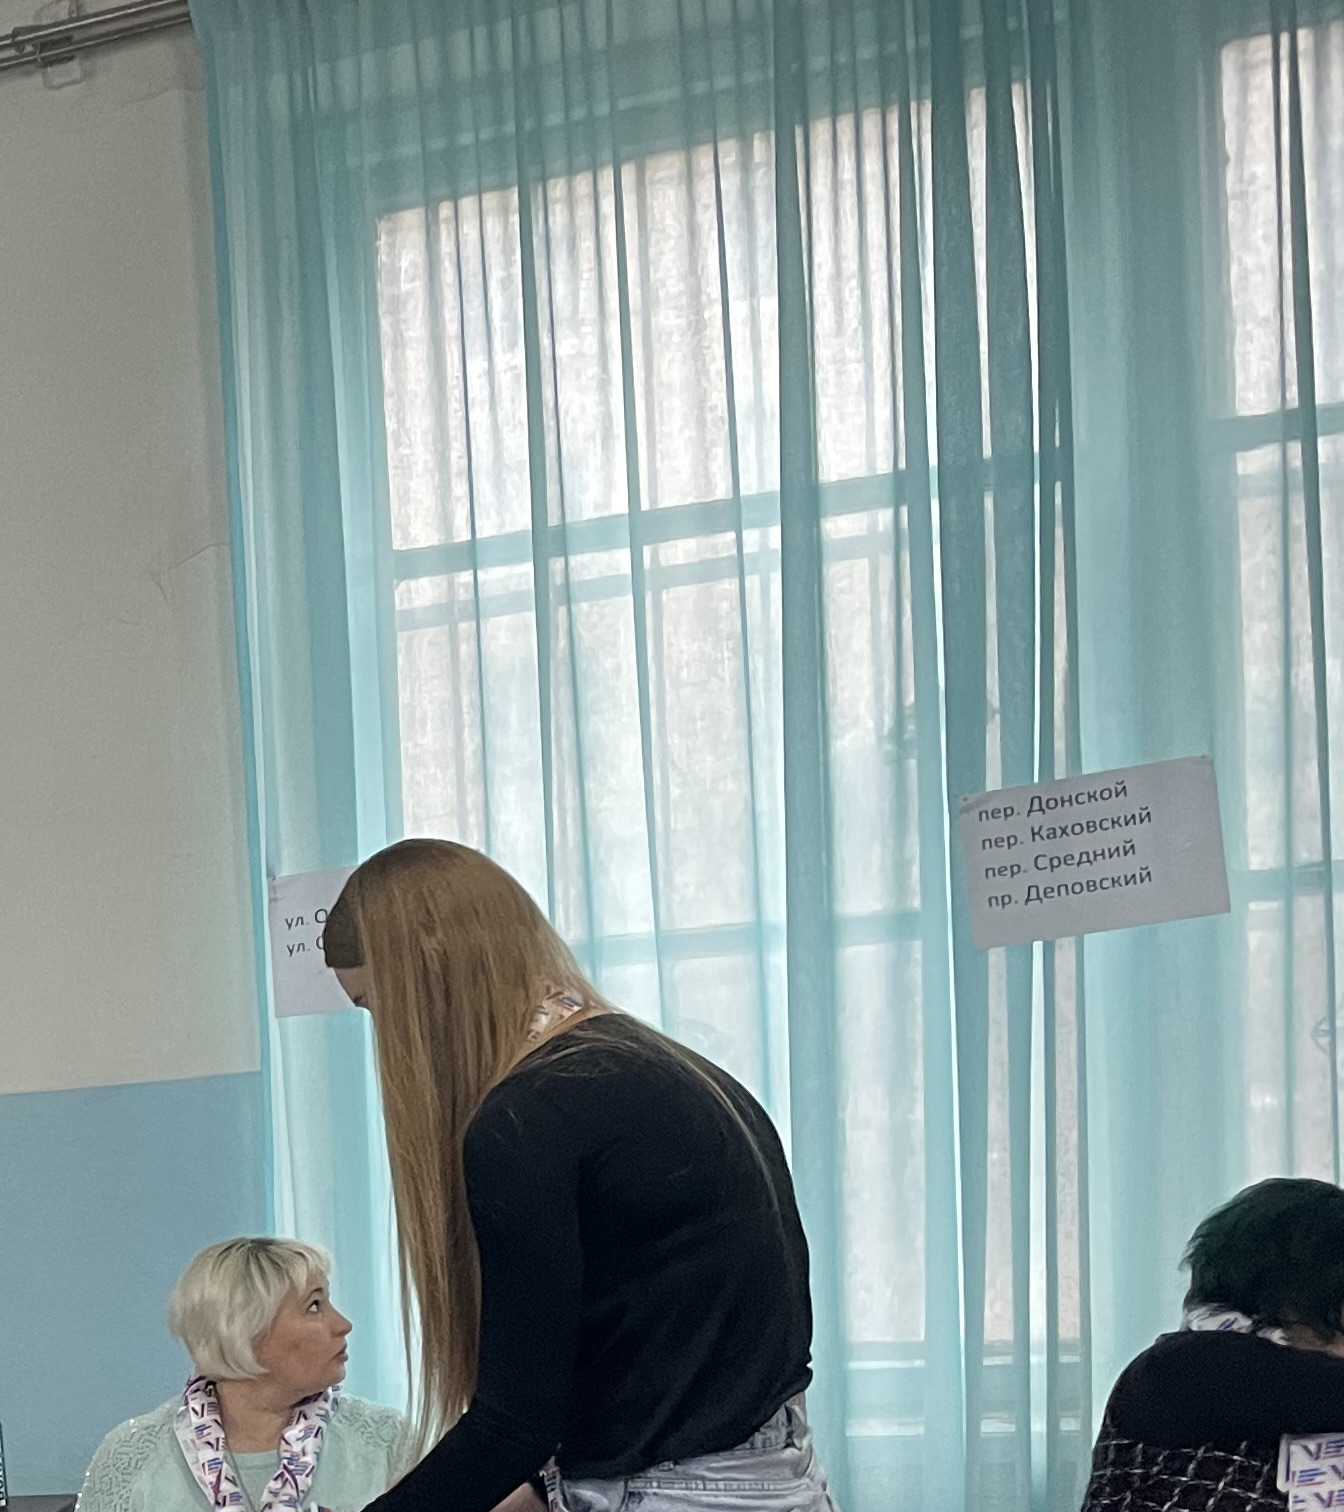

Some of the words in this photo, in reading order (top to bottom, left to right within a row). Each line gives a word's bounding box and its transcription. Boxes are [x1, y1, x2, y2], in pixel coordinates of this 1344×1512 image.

[978, 805, 1022, 823] пер.
[1027, 780, 1128, 817] Донской
[981, 832, 1025, 851] пер.
[1030, 806, 1152, 843] Каховский
[984, 861, 1028, 880] пер.
[1033, 839, 1137, 873] Средний
[987, 892, 1019, 909] пр.
[1024, 866, 1153, 906] Деповский
[284, 915, 310, 931] ул.
[286, 942, 311, 957] ул.
